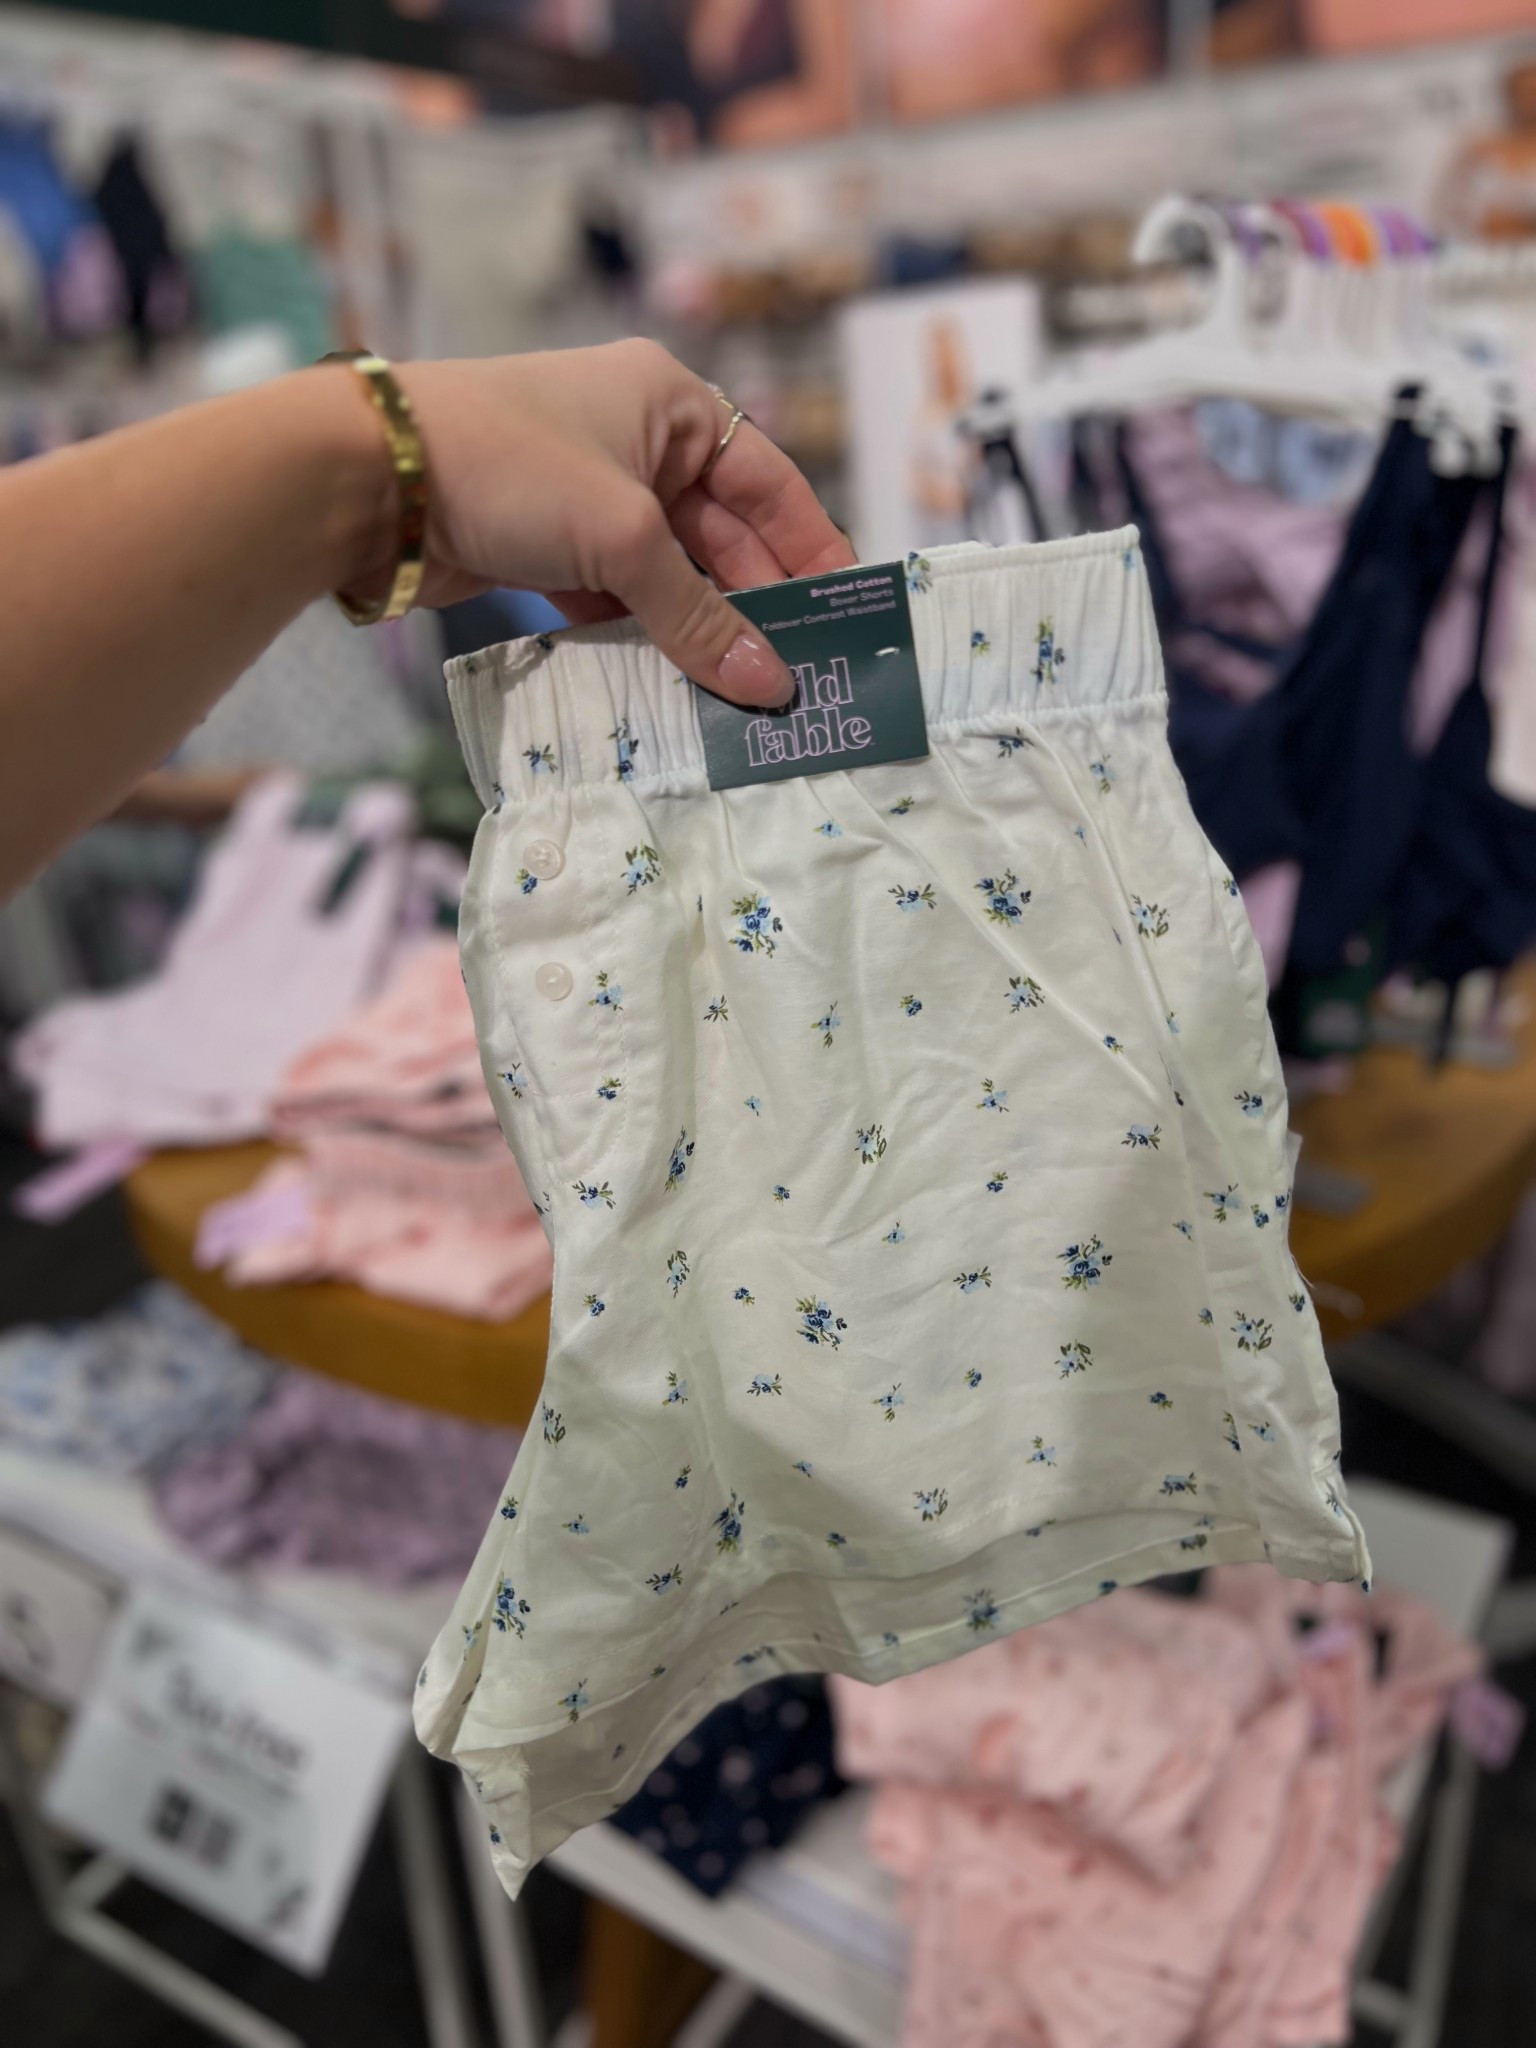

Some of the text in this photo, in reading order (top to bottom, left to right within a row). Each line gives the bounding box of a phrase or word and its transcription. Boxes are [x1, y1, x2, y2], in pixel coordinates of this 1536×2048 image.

[810, 575, 893, 598] Brushed Cotton
[829, 588, 895, 607] Boxer Shorts
[803, 610, 846, 625] Contrast
[845, 599, 897, 617] Waistband
[760, 656, 854, 716] ild
[744, 706, 872, 767] fable
